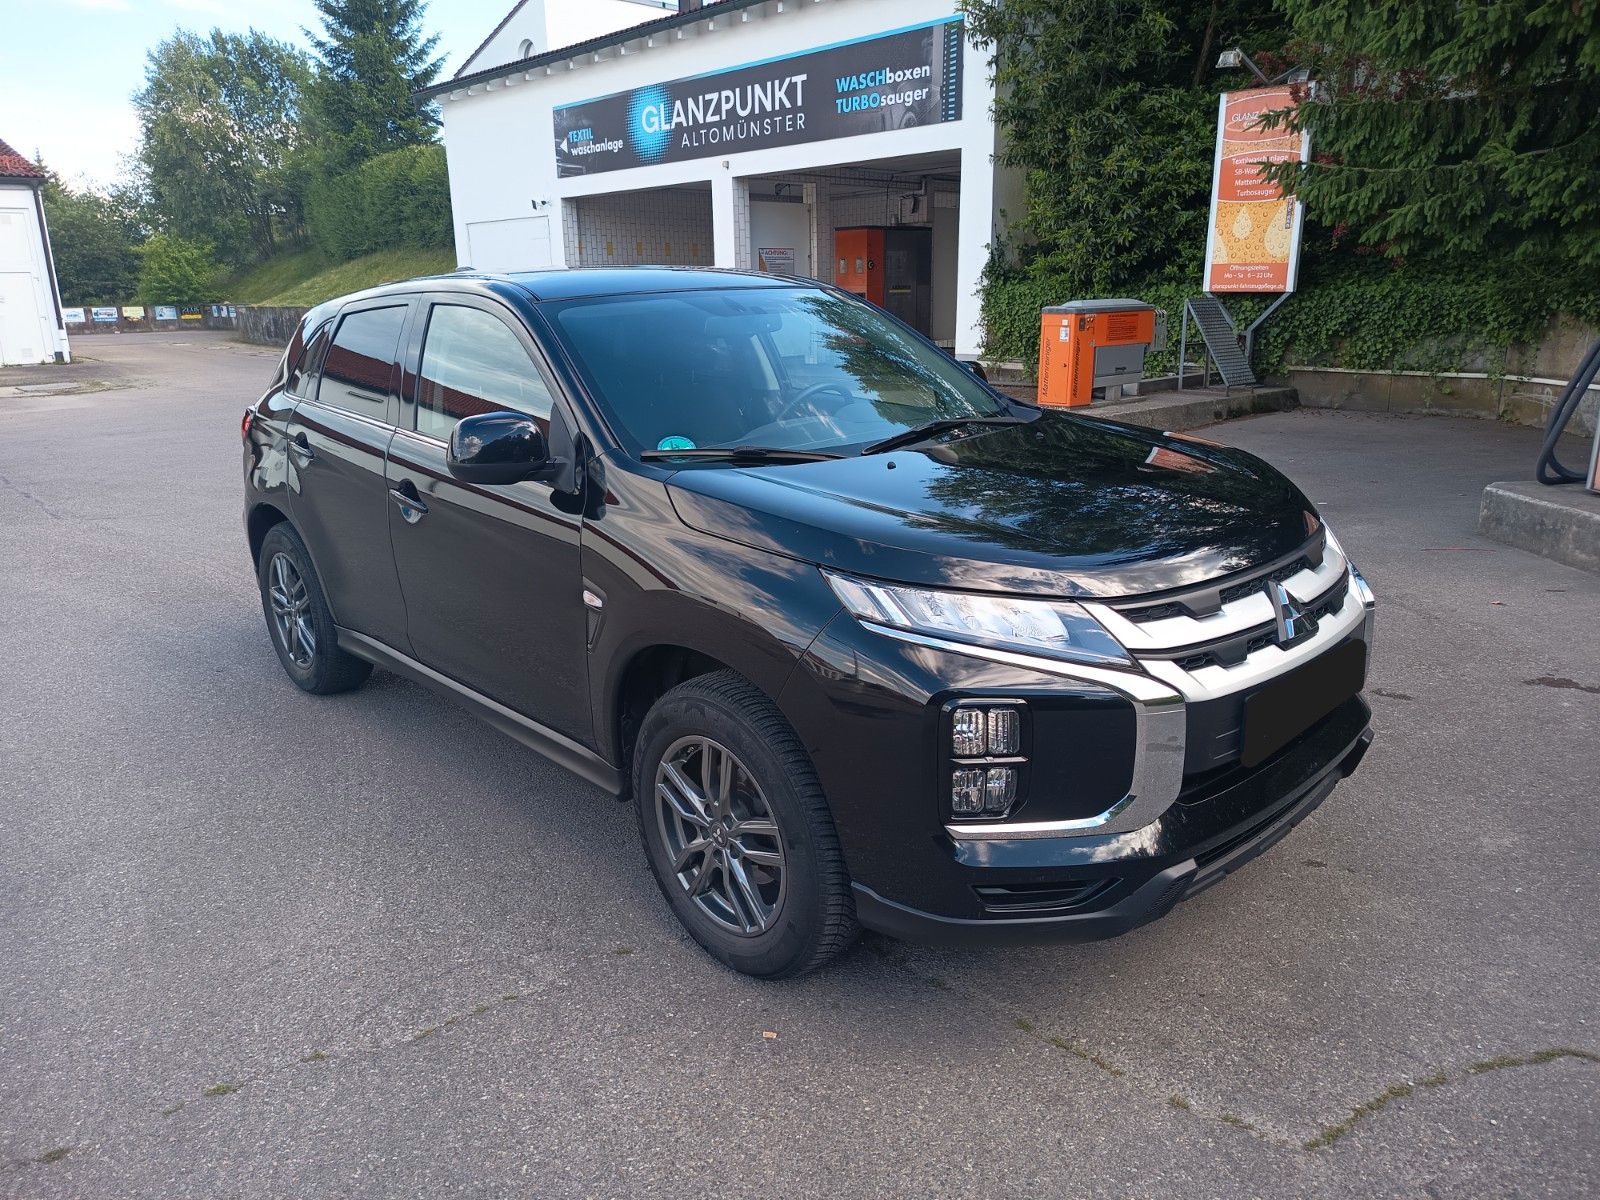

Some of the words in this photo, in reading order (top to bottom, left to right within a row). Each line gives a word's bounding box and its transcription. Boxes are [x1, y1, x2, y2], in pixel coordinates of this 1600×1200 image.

[835, 65, 930, 93] WASCHboxen
[641, 74, 808, 134] GLANZPUNKT
[835, 87, 929, 114] TURBOsauger
[568, 127, 594, 143] TEXTIL
[681, 113, 806, 149] ALTOMÜNSTER
[570, 137, 624, 156] waschanlage
[1232, 154, 1289, 165] Textilwaschnlage
[1236, 189, 1276, 197] Turbosauger
[1042, 338, 1051, 398] Mattenreiniger
